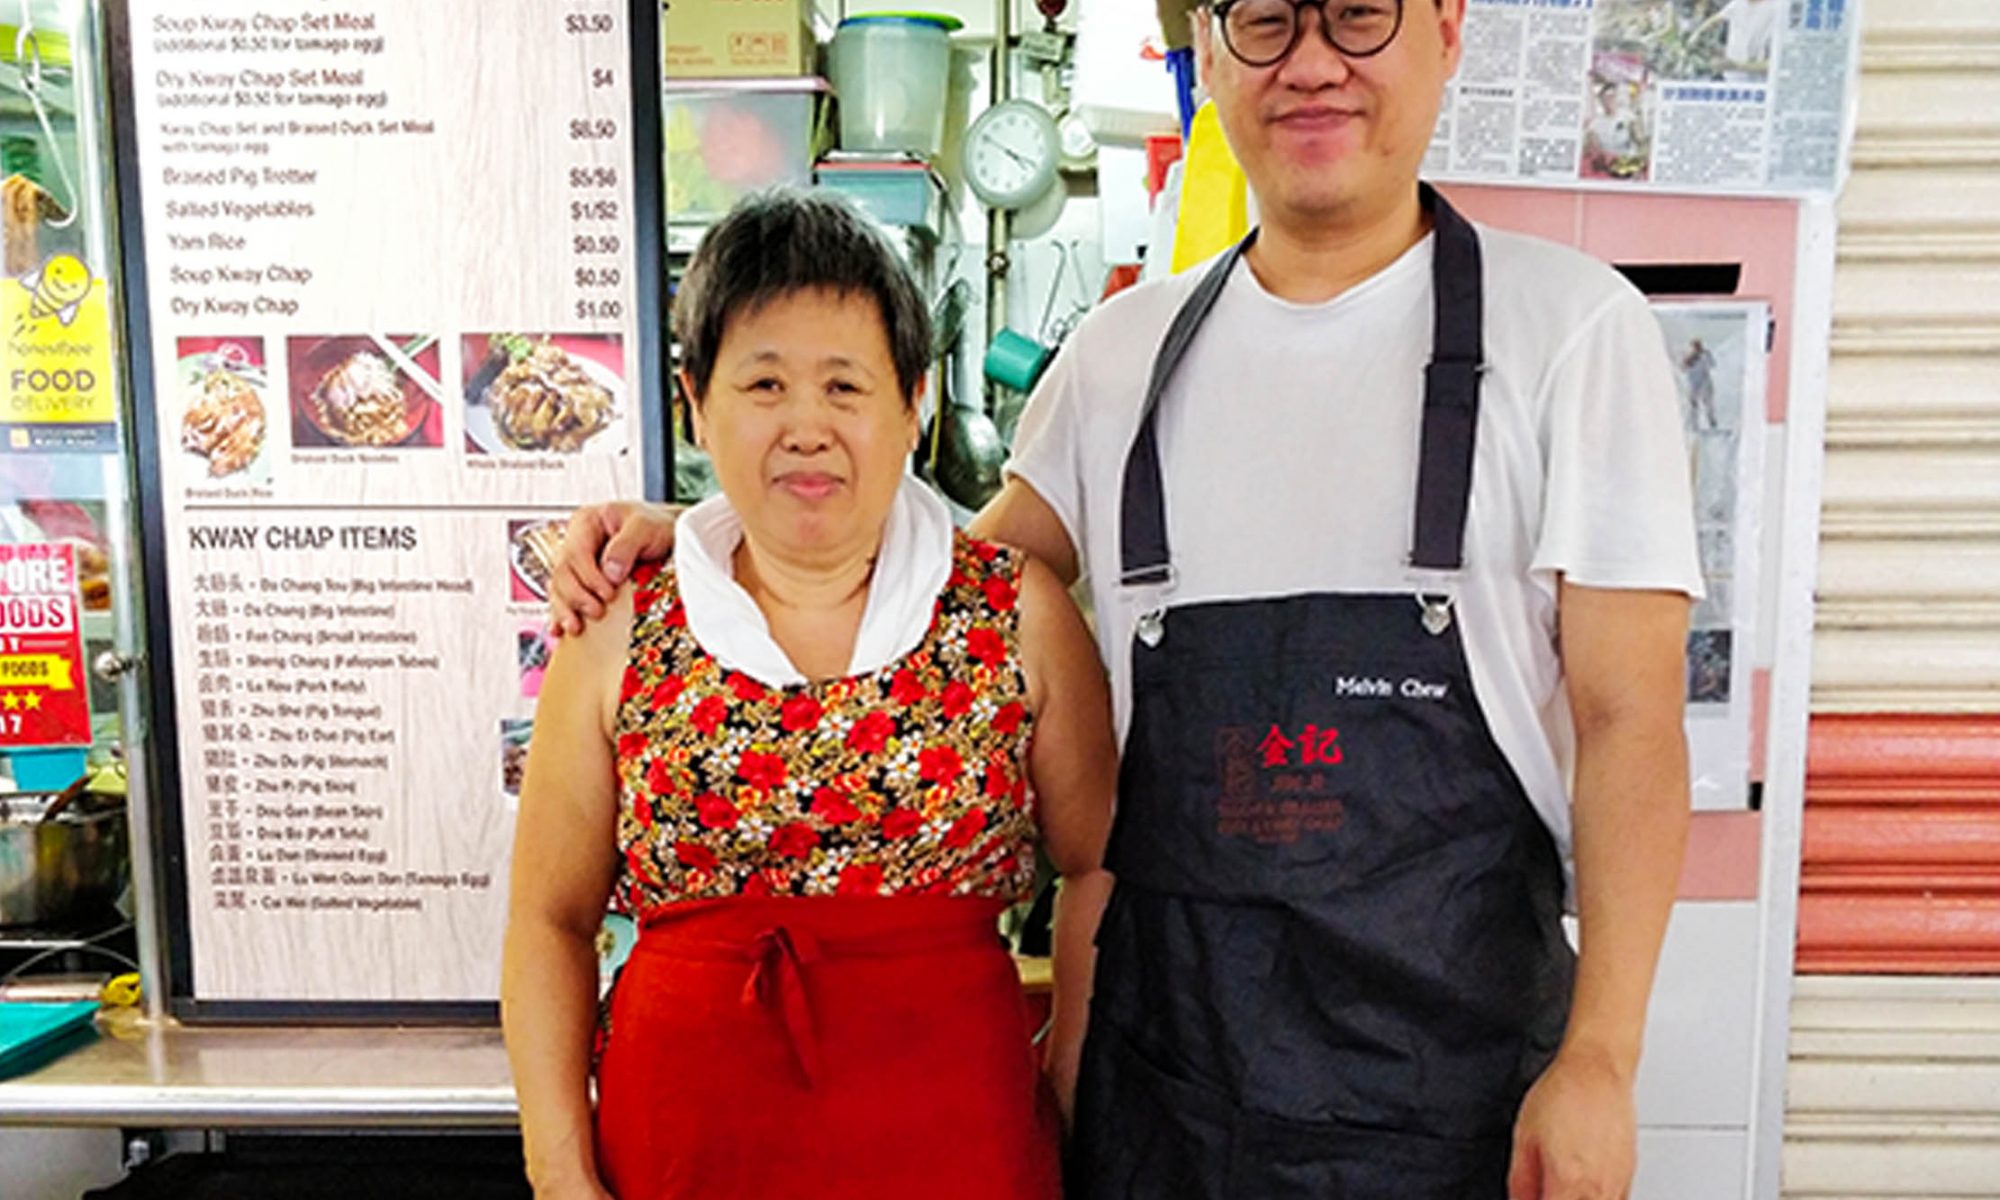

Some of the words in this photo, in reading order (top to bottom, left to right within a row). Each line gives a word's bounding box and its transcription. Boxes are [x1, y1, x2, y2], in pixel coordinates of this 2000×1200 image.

[153, 15, 197, 33] Soup
[201, 15, 246, 33] Kway
[252, 12, 297, 32] Chap
[301, 12, 329, 30] Set
[334, 13, 375, 30] Meal
[566, 14, 613, 34] $3.50
[156, 70, 184, 88] Dry
[189, 70, 235, 88] Kway
[240, 69, 285, 88] Chap
[289, 69, 318, 86] Set
[322, 69, 364, 86] Meal
[592, 68, 614, 88] $4
[165, 200, 220, 218] Salted
[222, 200, 315, 222] Vegetables
[167, 233, 204, 250] Yam
[207, 232, 246, 250] Rice
[573, 235, 620, 254] $0.50
[170, 265, 213, 285] Soup
[216, 265, 263, 285] Kway
[267, 264, 313, 285] Chap
[575, 267, 621, 287] $0.50
[170, 297, 201, 318] Dry
[204, 298, 249, 318] Kway
[253, 296, 299, 316] Chap
[575, 300, 622, 319] $1.00
[11, 369, 95, 392] FOOD
[188, 526, 259, 549] KWAY
[265, 526, 334, 549] CHAP
[339, 526, 417, 550] ITEMS
[1335, 677, 1393, 697] Melvin
[1400, 677, 1450, 699] Chew
